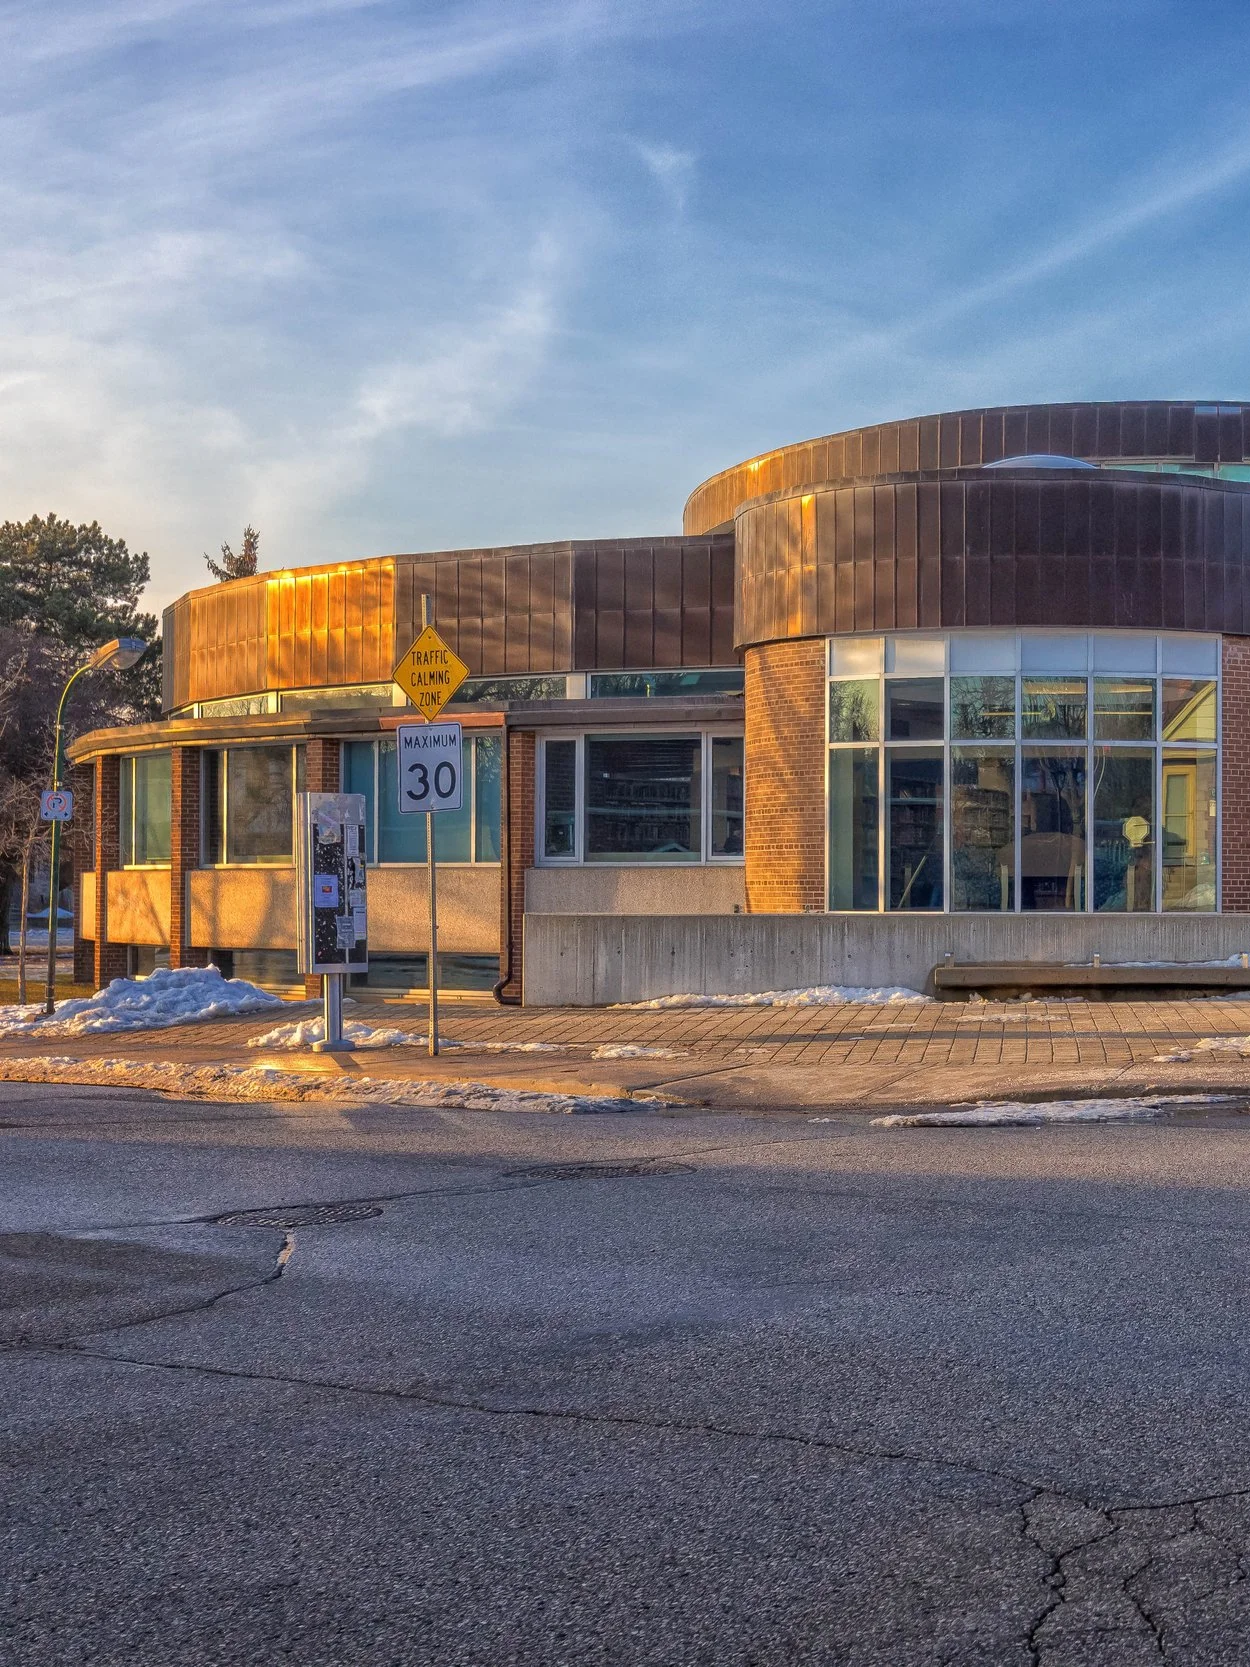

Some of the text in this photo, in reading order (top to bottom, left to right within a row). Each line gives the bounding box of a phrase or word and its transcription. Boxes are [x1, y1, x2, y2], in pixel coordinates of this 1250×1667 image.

[411, 650, 449, 667] TRAFFIC
[411, 670, 450, 687] CALMING
[419, 691, 442, 707] ZONE
[404, 734, 457, 750] MAXIMUM
[406, 761, 456, 801] 30
